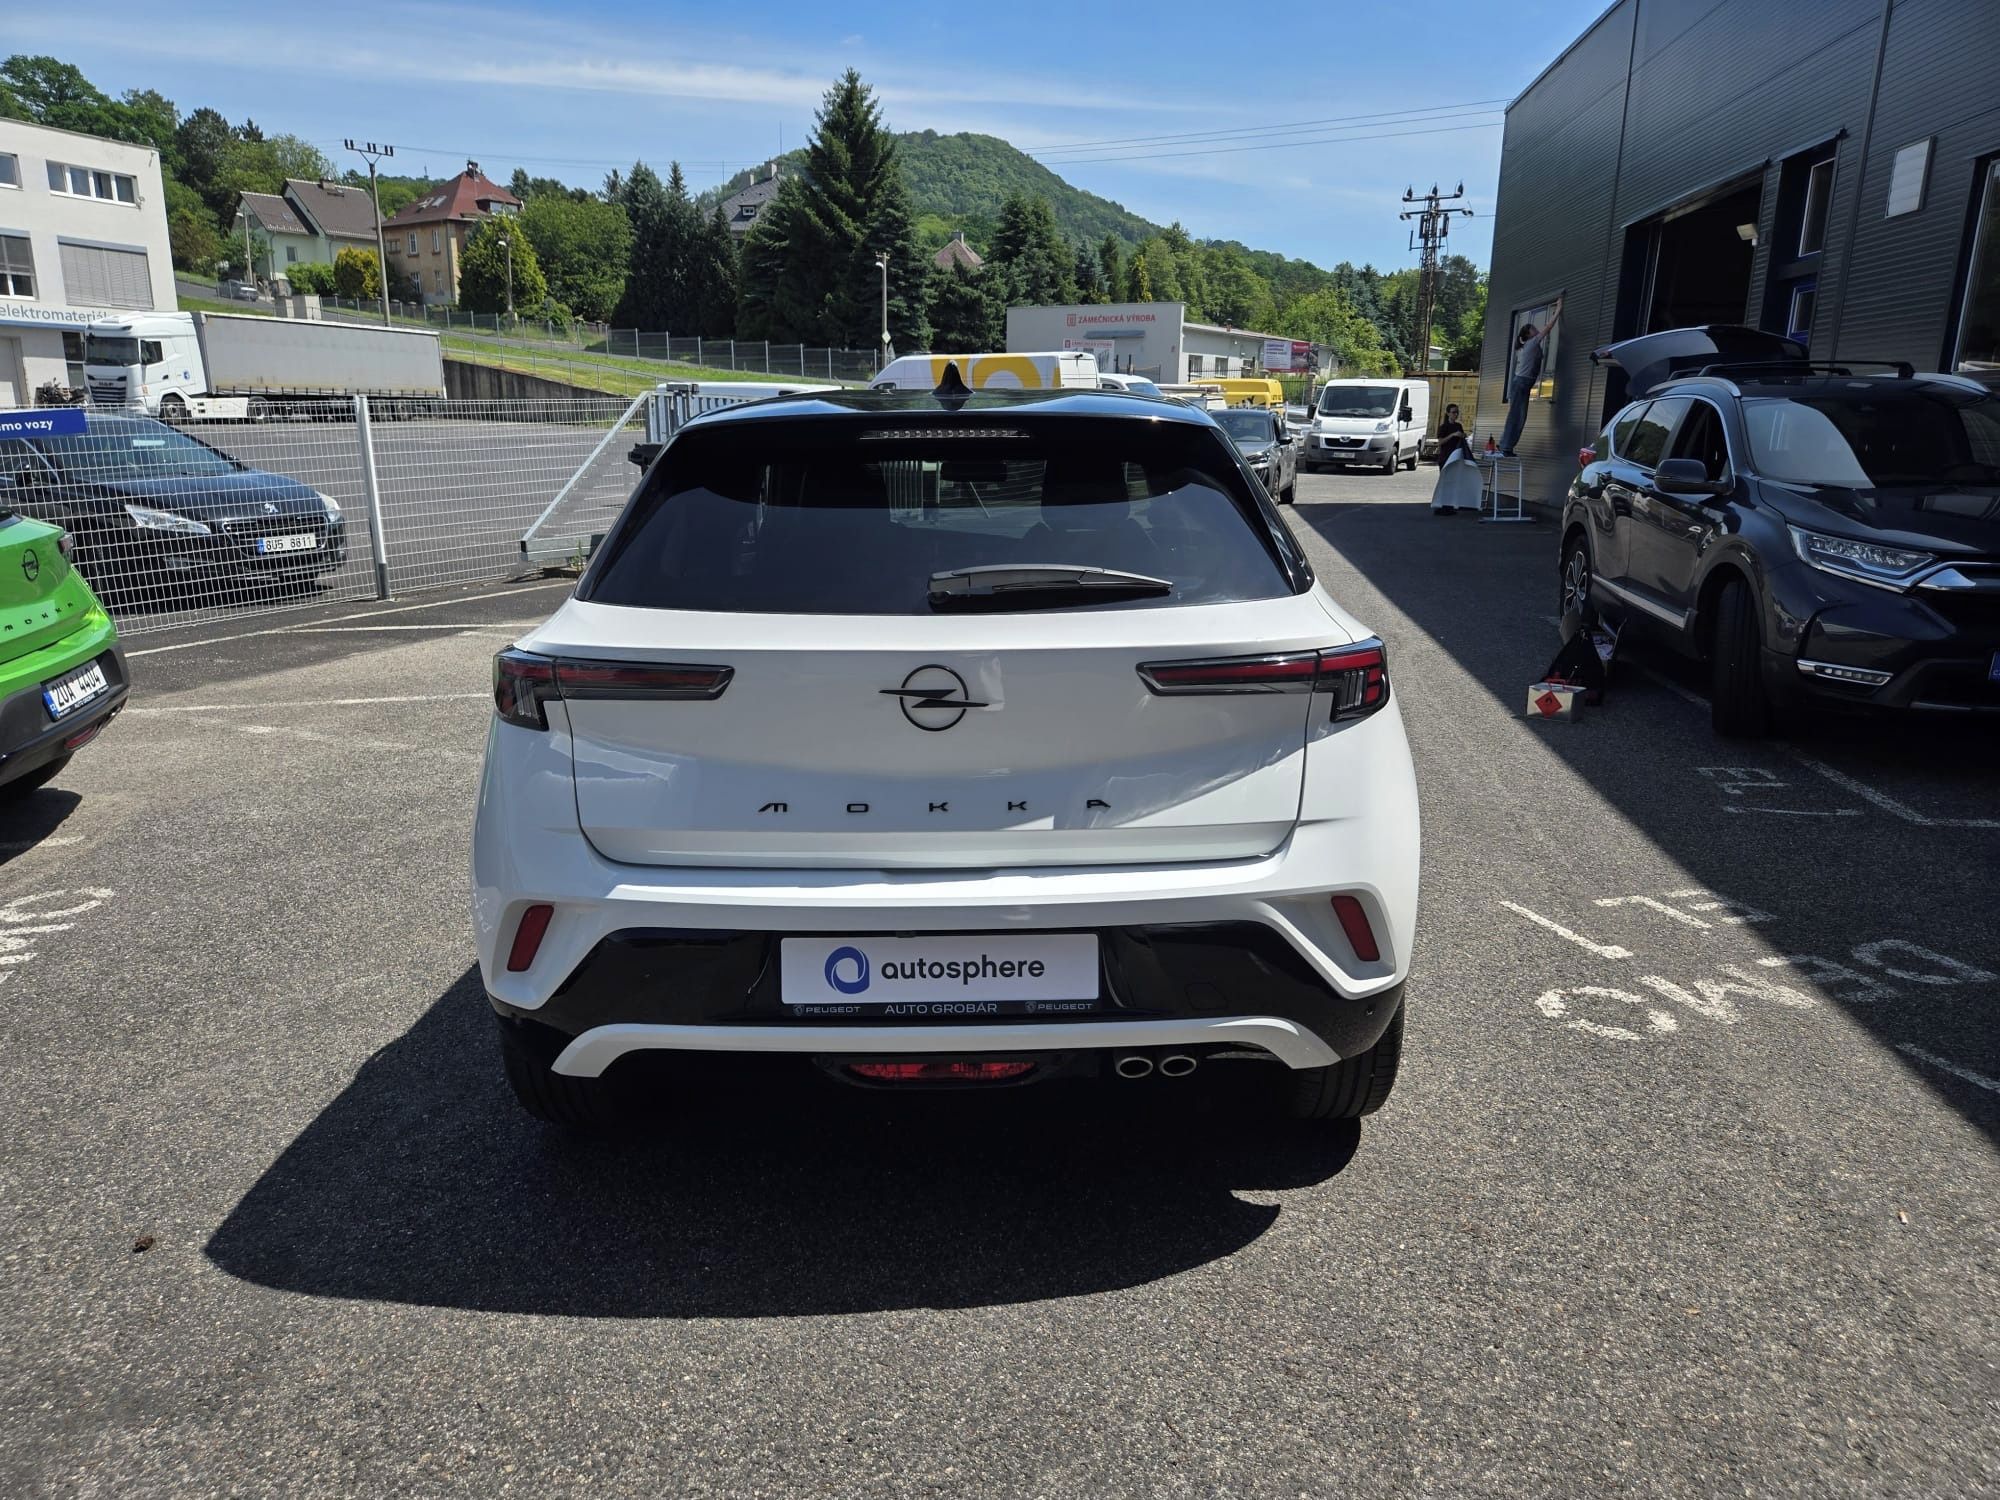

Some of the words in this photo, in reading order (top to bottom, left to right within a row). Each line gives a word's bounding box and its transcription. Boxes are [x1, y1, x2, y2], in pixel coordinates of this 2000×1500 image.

[1127, 312, 1156, 322] VÝROBA
[0, 422, 22, 431] mo
[25, 420, 53, 431] vozy
[758, 799, 1112, 814] MOKKA
[881, 953, 1045, 985] autosphere
[805, 1006, 861, 1014] PEUGEOT
[885, 1004, 928, 1015] AUTO
[931, 1002, 998, 1014] GROBÁR
[1038, 1003, 1093, 1011] PEUGEOT
